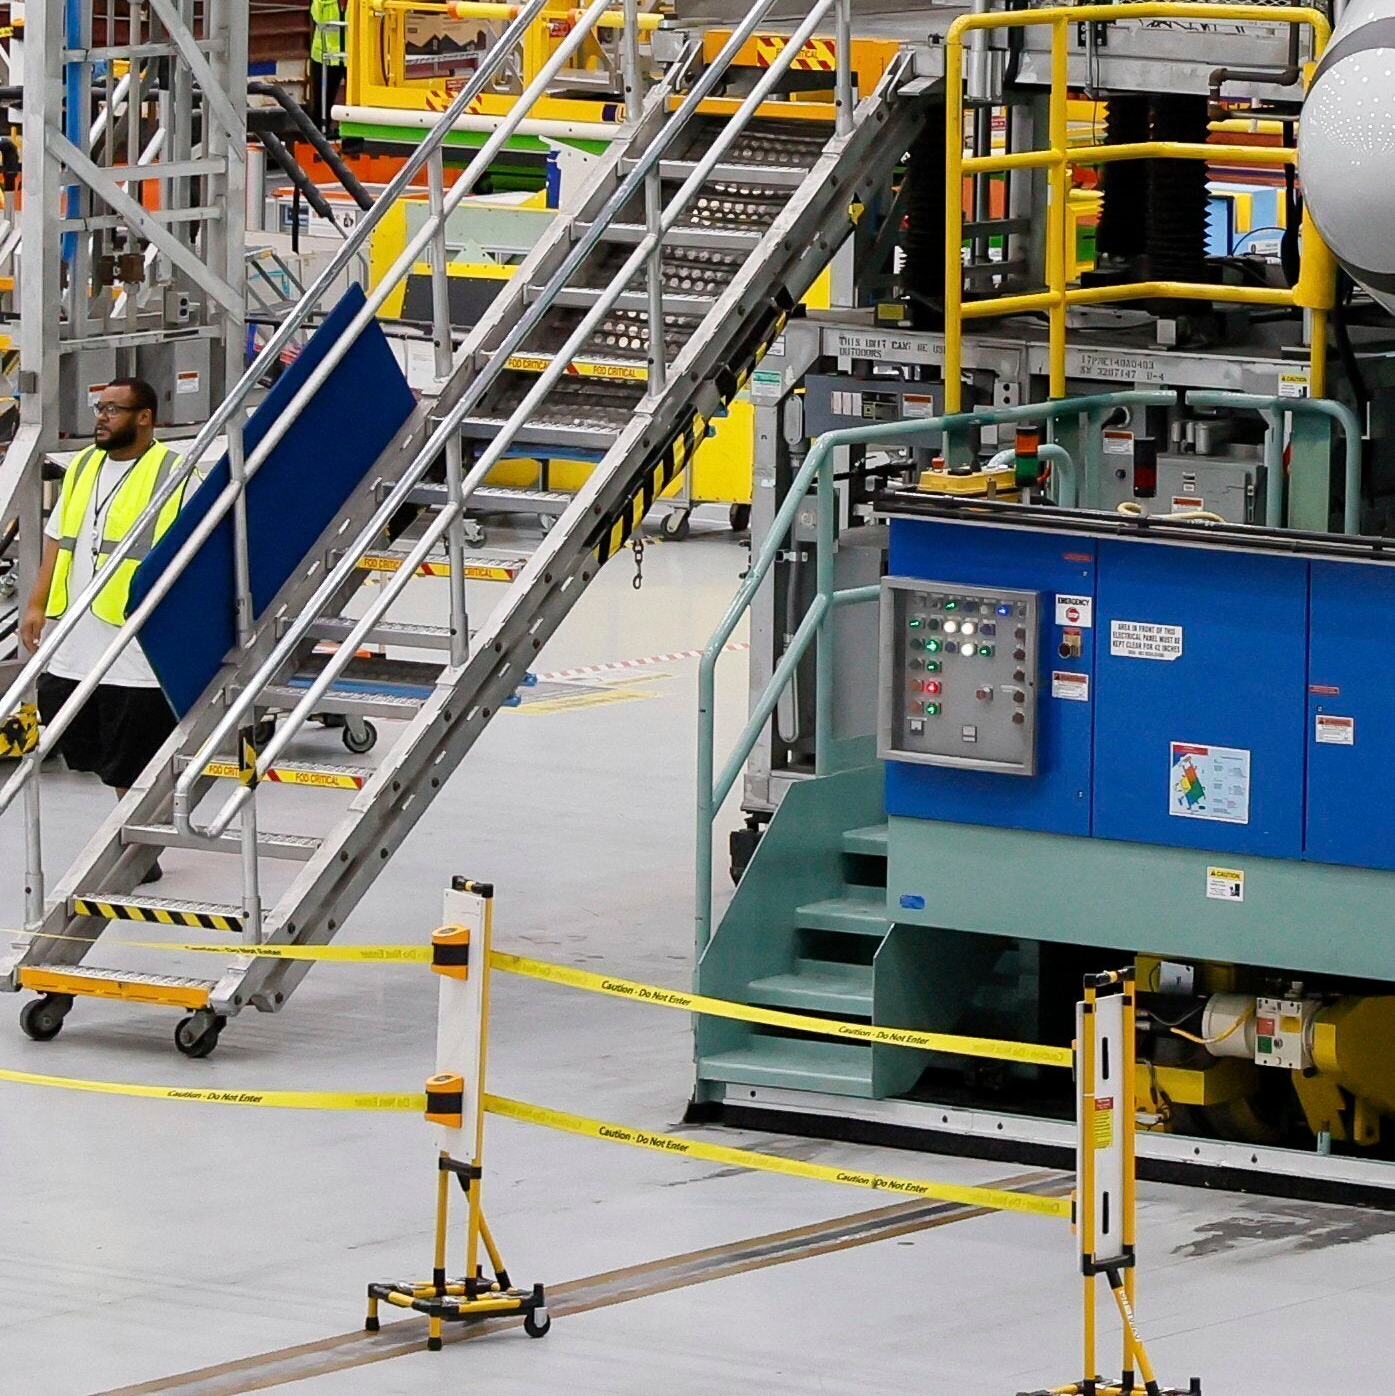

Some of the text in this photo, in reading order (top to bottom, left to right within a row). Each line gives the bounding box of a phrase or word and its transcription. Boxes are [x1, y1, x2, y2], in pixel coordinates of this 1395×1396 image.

[523, 360, 547, 371] CRITICA
[593, 364, 637, 378] FOD CRITICAL
[209, 764, 239, 777] FOD CRIT
[295, 772, 340, 786] FOD CRITICAL
[601, 979, 692, 1006] Caution Do Not Enter
[838, 1025, 930, 1045] Caution Do Not Enter
[167, 1090, 263, 1104] Caution Do Not Enter
[598, 1125, 690, 1153] Caution Do Not Enter
[836, 1172, 928, 1195] Caution Do Not Enter
